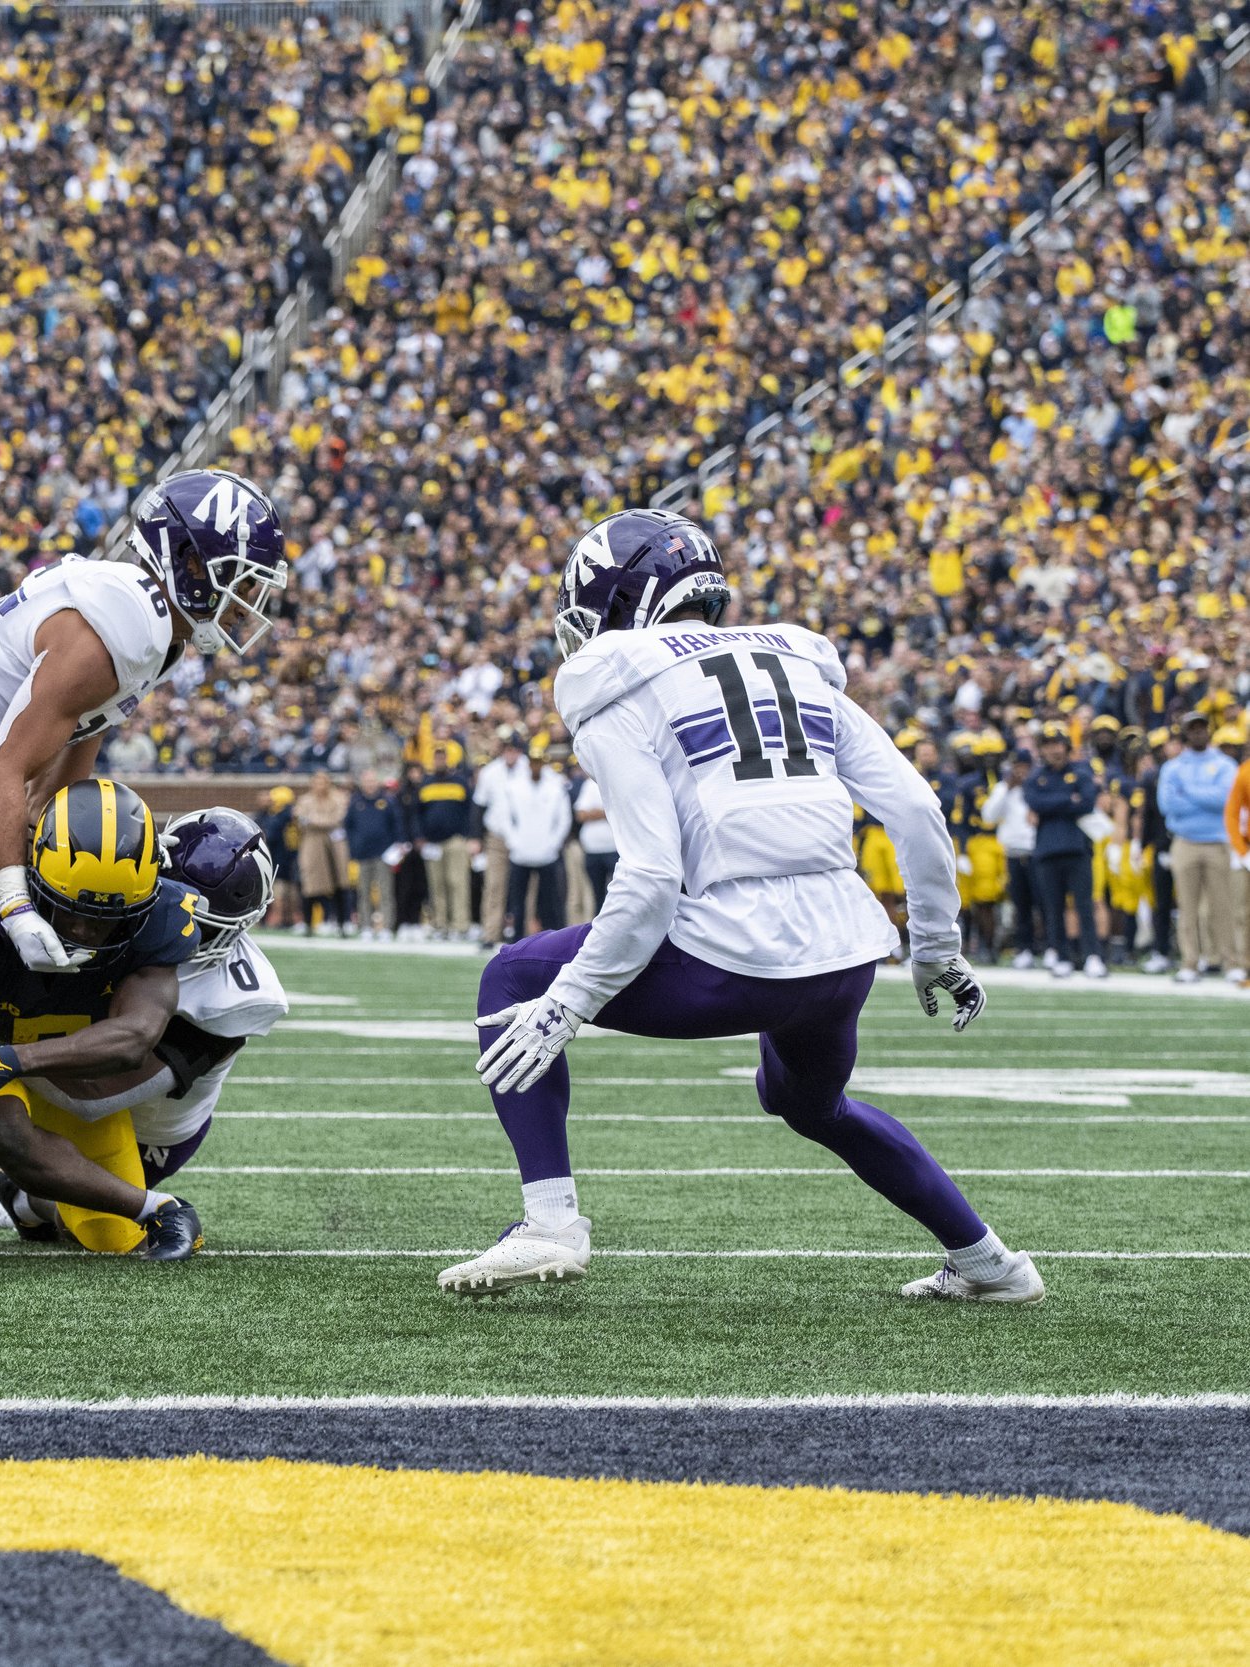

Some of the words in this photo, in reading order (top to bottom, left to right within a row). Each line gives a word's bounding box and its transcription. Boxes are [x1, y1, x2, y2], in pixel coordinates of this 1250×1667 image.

[191, 477, 254, 536] N
[136, 577, 168, 619] 16
[659, 632, 794, 658] HAMPTON
[697, 652, 820, 782] 11
